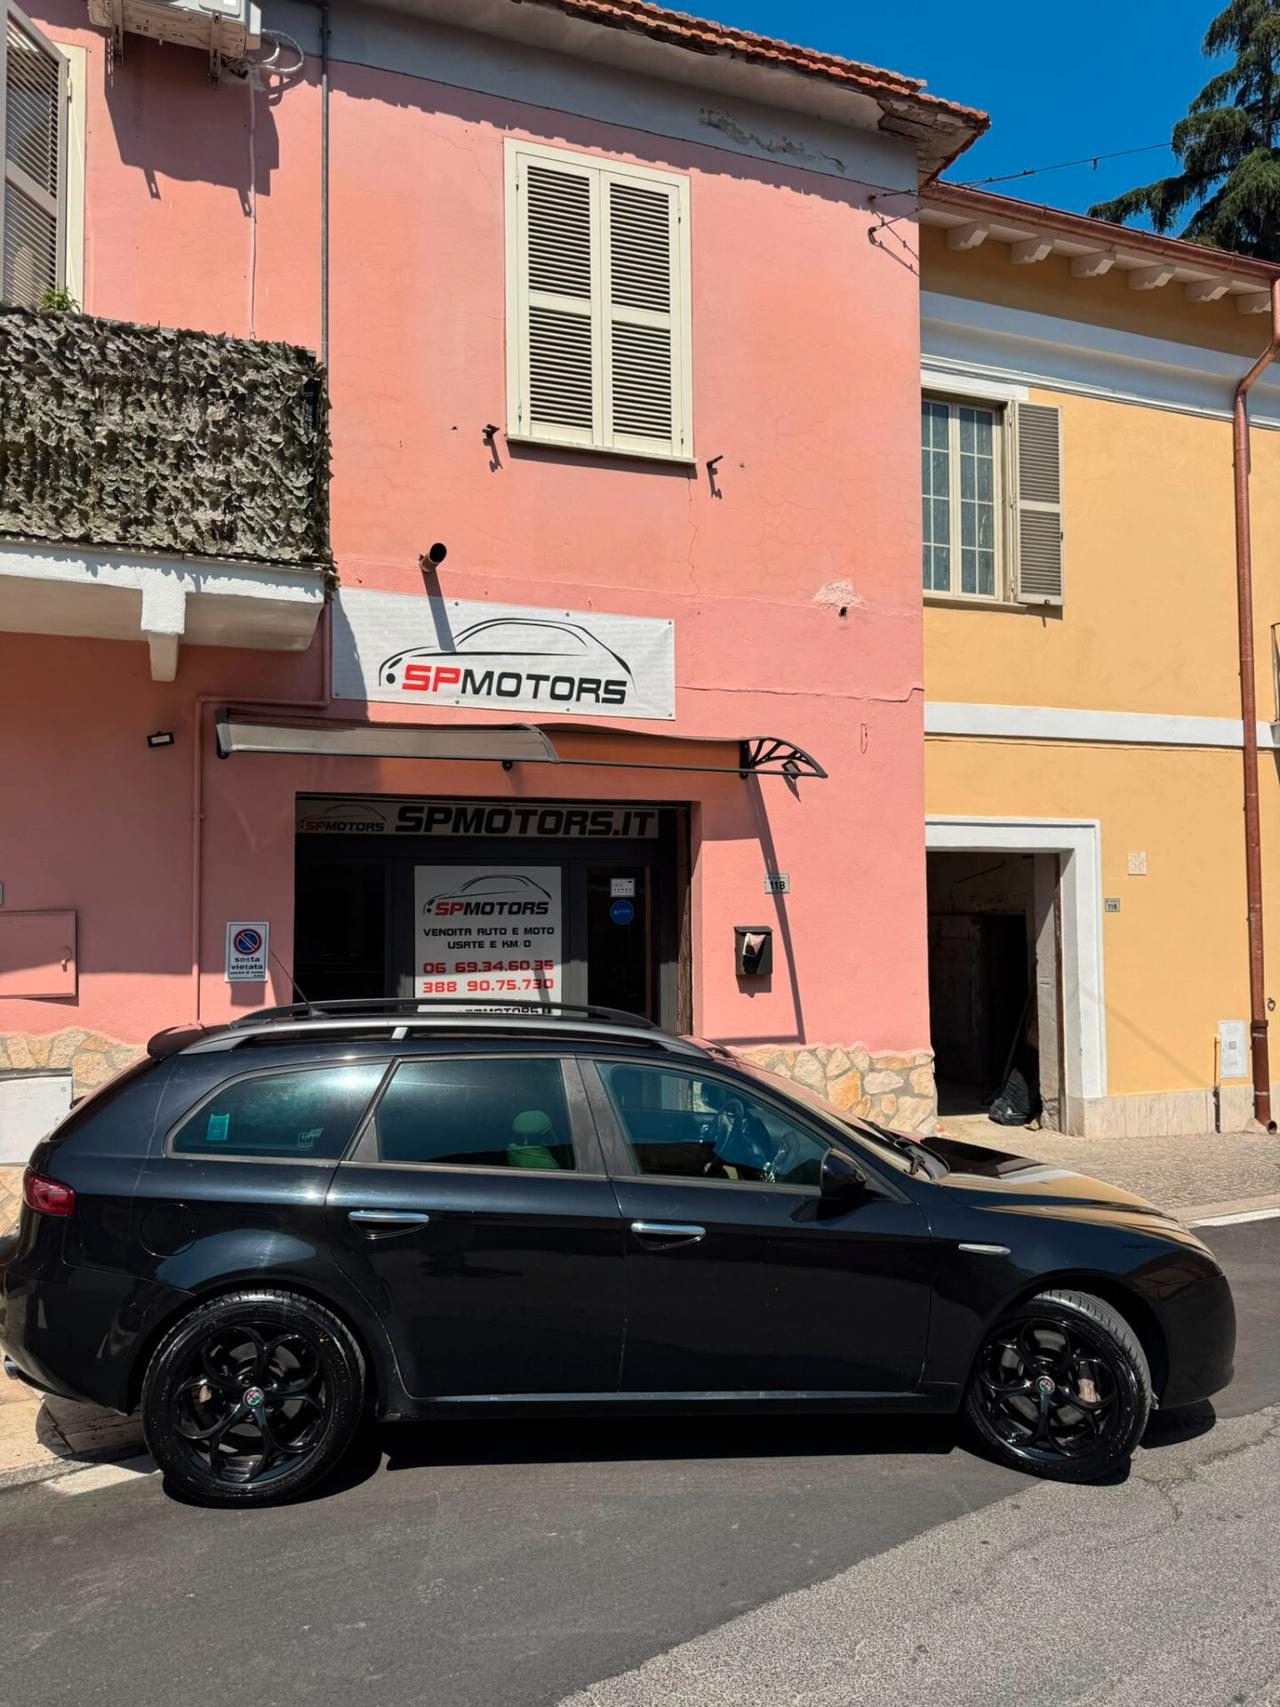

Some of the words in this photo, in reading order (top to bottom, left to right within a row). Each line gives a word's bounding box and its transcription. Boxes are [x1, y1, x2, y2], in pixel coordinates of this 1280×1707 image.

[402, 664, 627, 704] SPMOTORS
[305, 819, 385, 832] SPMOTORS
[395, 805, 655, 837] SPMOTORS.IT
[770, 881, 785, 890] 118
[434, 901, 550, 916] SPMOTORS
[423, 927, 472, 937] VENDITA
[476, 927, 508, 936] AUTO
[511, 927, 519, 936] E
[523, 926, 555, 935] MOTO
[447, 940, 486, 949] USATE
[489, 940, 497, 949] E
[501, 940, 519, 949] KM
[423, 962, 447, 974] 06
[454, 960, 554, 974] 69.34.60.35
[422, 981, 458, 993] 388
[466, 978, 554, 992] 90.75.730
